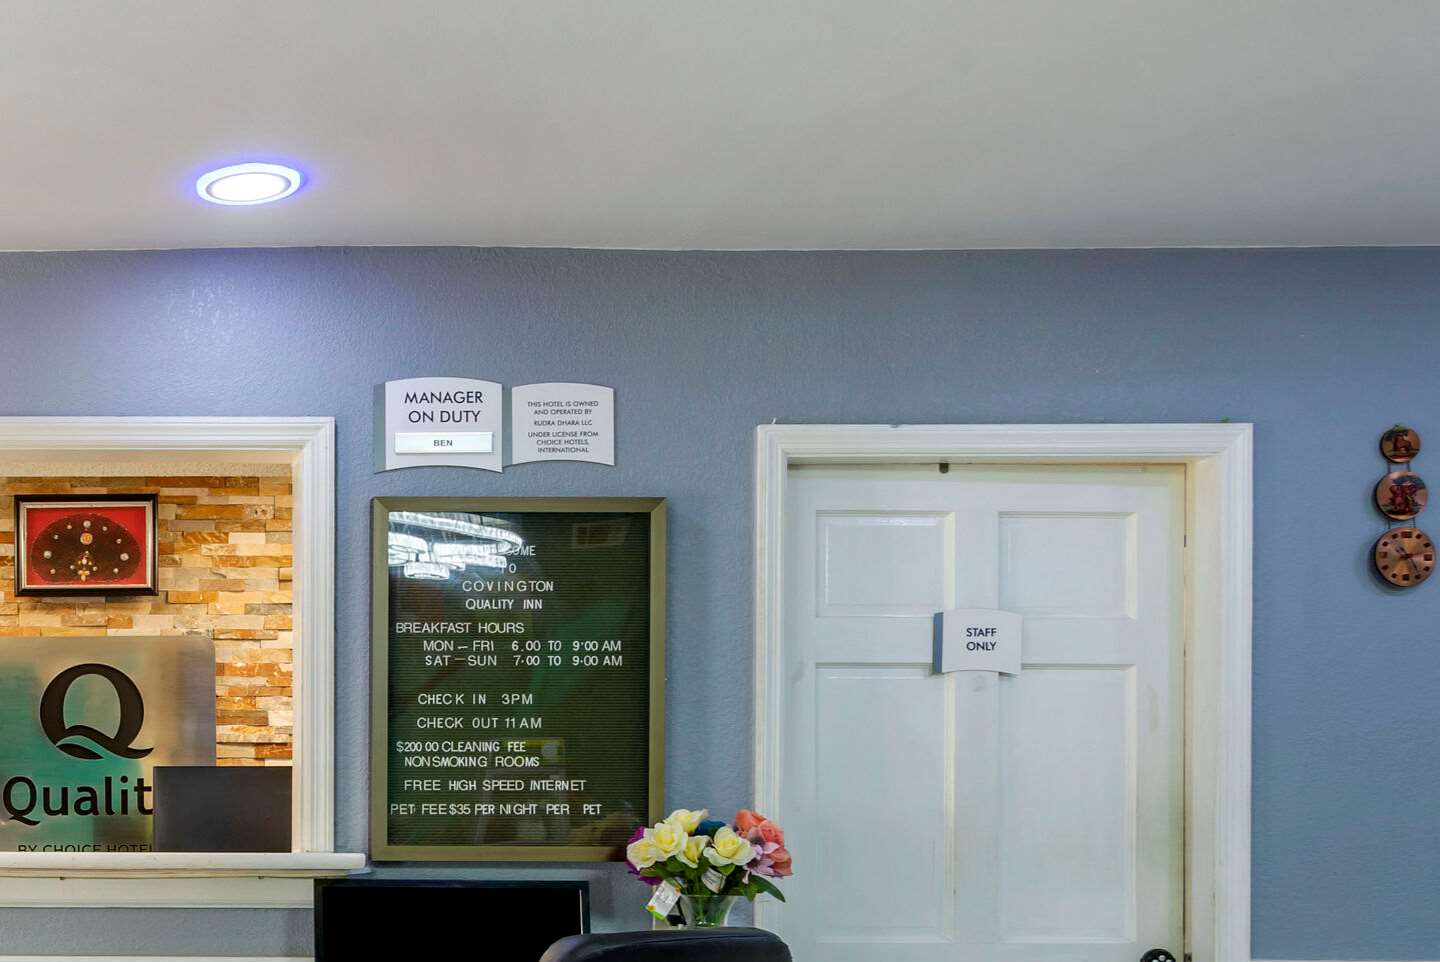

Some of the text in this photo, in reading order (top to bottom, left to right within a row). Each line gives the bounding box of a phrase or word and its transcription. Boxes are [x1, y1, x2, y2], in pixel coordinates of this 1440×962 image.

[404, 391, 483, 404] MANAGER
[408, 410, 480, 423] ON DUTY
[462, 581, 554, 592] COVINGTON
[466, 599, 542, 610] QUALITY INN
[396, 623, 524, 634] BREAKFAST HOURS
[966, 628, 997, 637] STAFF
[424, 640, 454, 651] MON
[473, 640, 494, 651] FRI
[548, 640, 561, 651] TO
[602, 640, 622, 651] AM
[966, 642, 996, 651] ONLY
[426, 656, 450, 666] SAT
[468, 656, 496, 666] SUN
[548, 656, 561, 666] TO
[603, 656, 622, 666] AM
[418, 694, 532, 704] CHECK IN 3PM
[417, 718, 463, 728] CHECK
[442, 742, 500, 752] CLEANING
[508, 742, 526, 752] FEE
[495, 756, 539, 767] ROOMS
[404, 780, 586, 791] FREE HIGH SPEED INTERNET
[2, 776, 153, 826] Qualit
[391, 804, 602, 815] PET FEE $35 PER NIGHT PER PET
